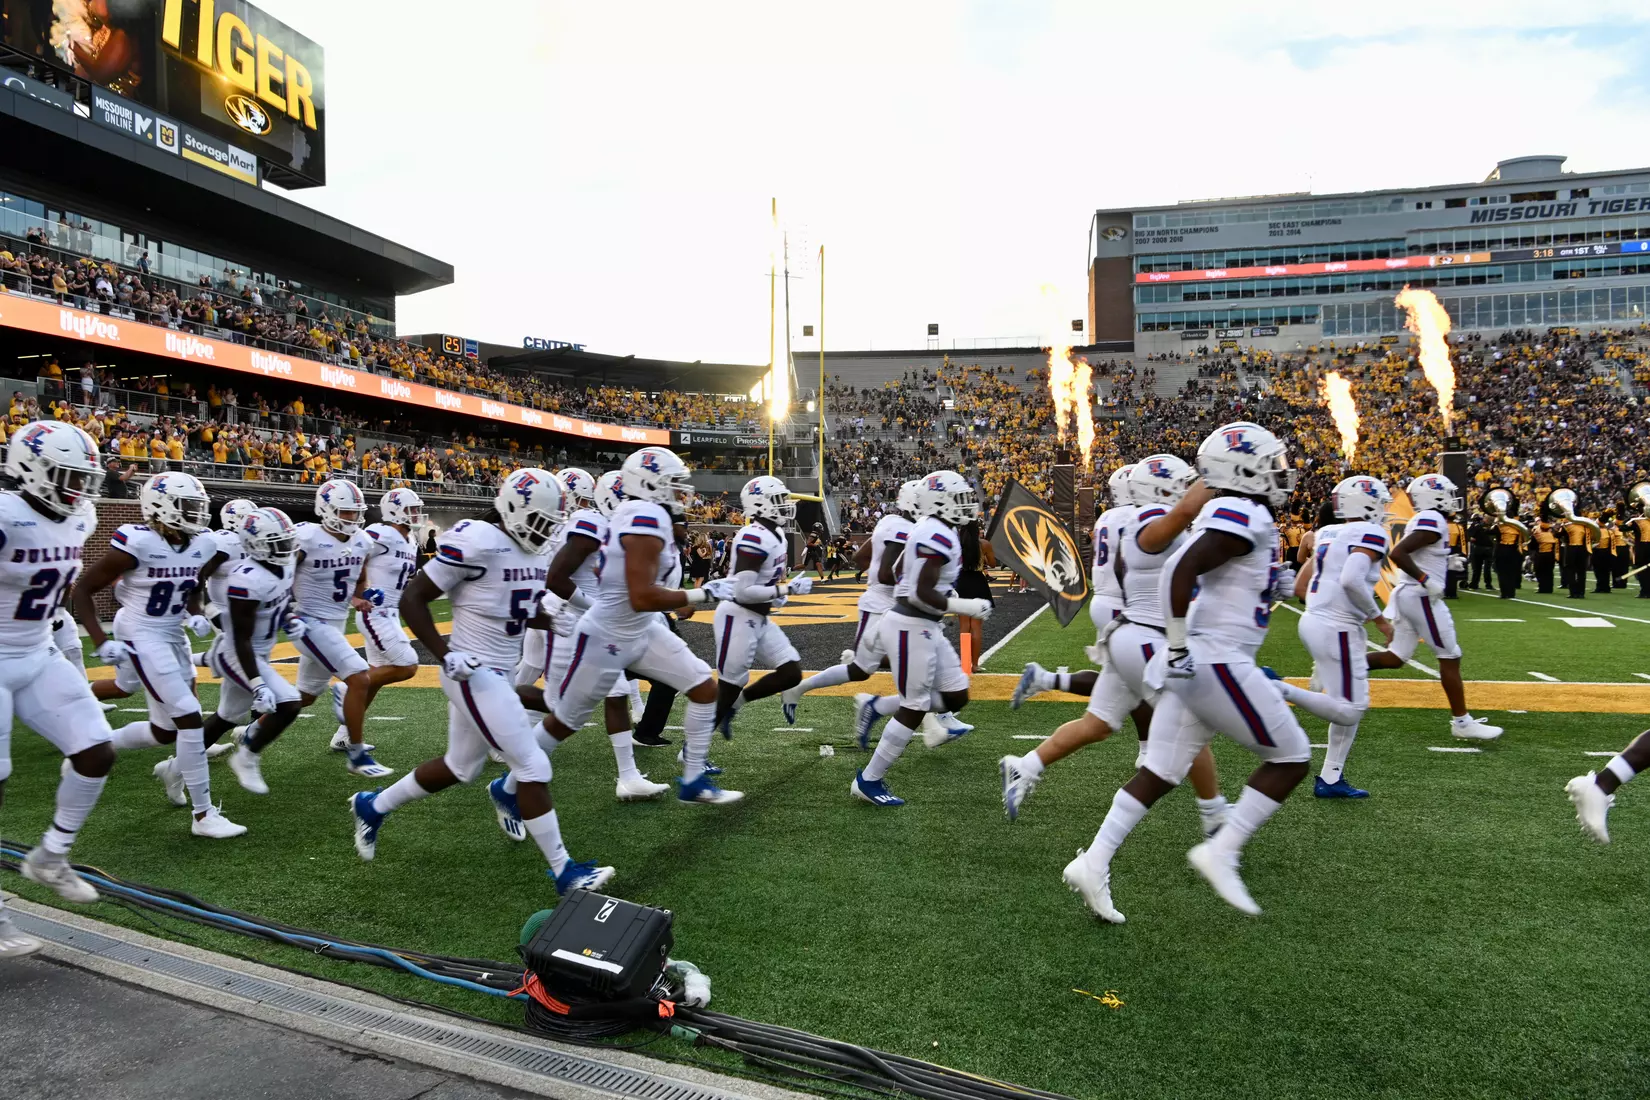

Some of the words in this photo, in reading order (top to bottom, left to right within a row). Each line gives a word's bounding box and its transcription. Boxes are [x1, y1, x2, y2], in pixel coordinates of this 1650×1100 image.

[95, 96, 132, 121] MISSOURI
[105, 111, 133, 132] ONLINE
[1470, 203, 1578, 223] MISSOURI
[1135, 230, 1145, 238] BIG
[1156, 228, 1178, 236] NORTH
[1179, 226, 1219, 235] CHAMPIONS
[1268, 221, 1281, 230] SEC
[1282, 220, 1299, 229] EAST
[1300, 218, 1342, 228] CHAMPIONS
[1135, 237, 1150, 245] 2007
[1152, 236, 1167, 244] 2008
[1169, 235, 1184, 243] 2010
[1533, 248, 1554, 258] 3:18
[1574, 246, 1590, 256] 1ST
[445, 336, 460, 352] 25
[692, 436, 728, 444] LEARFIELD
[1092, 526, 1110, 567] 6
[332, 568, 351, 603] 5
[146, 580, 198, 617] 83
